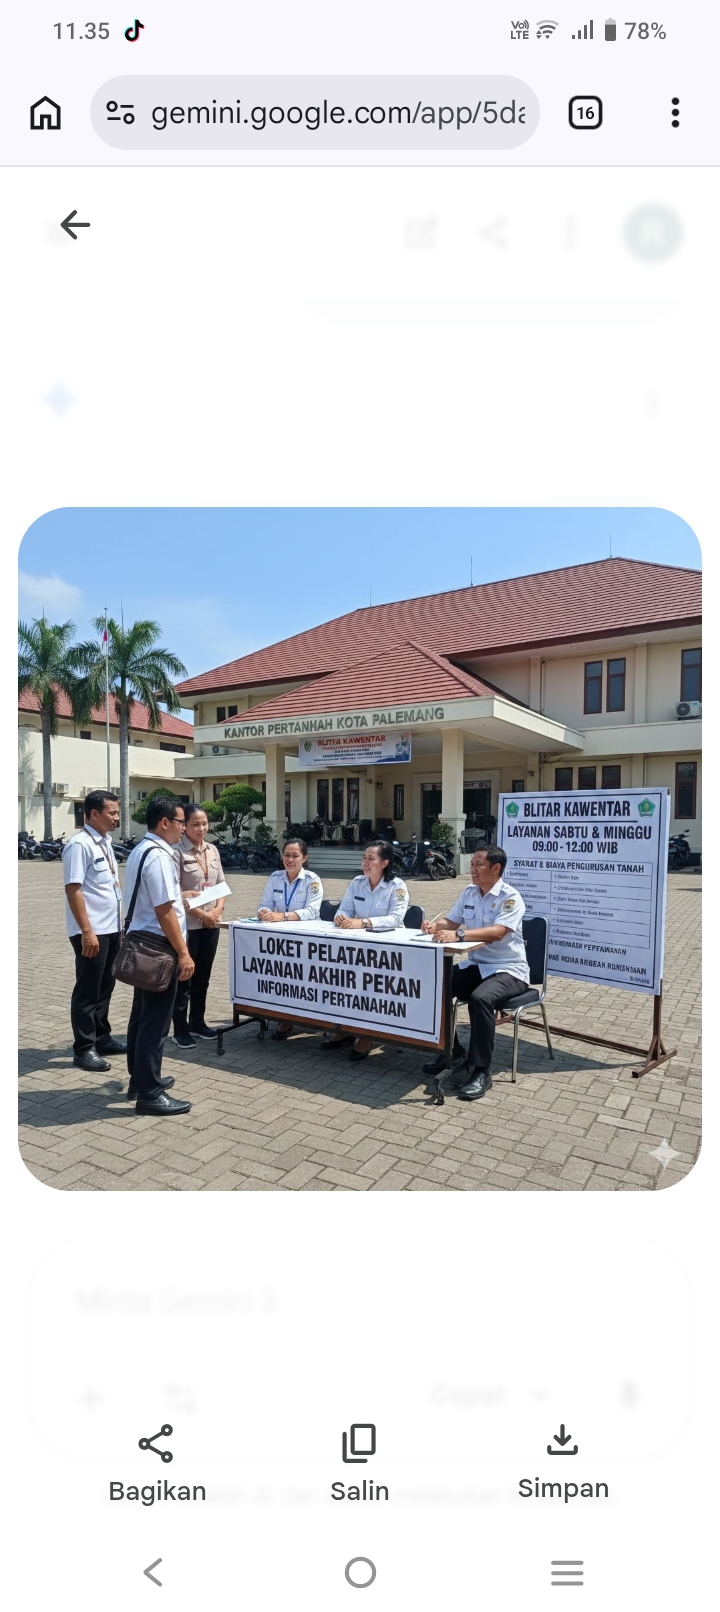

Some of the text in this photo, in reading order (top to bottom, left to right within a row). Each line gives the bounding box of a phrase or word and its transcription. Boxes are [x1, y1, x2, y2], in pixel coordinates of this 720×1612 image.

[53, 22, 110, 40] 11.35
[510, 30, 530, 40] LTE
[624, 22, 667, 40] 78%
[576, 106, 595, 120] 16
[224, 725, 265, 739] KANTOR
[336, 715, 368, 730] KOTA
[372, 707, 445, 726] PALEMANG
[523, 800, 631, 818] BLITAR KAWENTAR
[507, 826, 652, 840] LAYANAN SABTU & MINGGU
[597, 842, 618, 854] WIB
[513, 859, 538, 869] SYARAT
[616, 865, 645, 874] TANAH
[259, 936, 403, 972] LOKET PELATARAN
[242, 955, 421, 999] LAYANAN AKHIR PEKAN
[257, 979, 407, 1019] INFORMASI PERTANAHAN
[109, 1480, 207, 1507] Bagikan
[330, 1480, 390, 1501] Salin
[517, 1477, 610, 1504] Simpan
